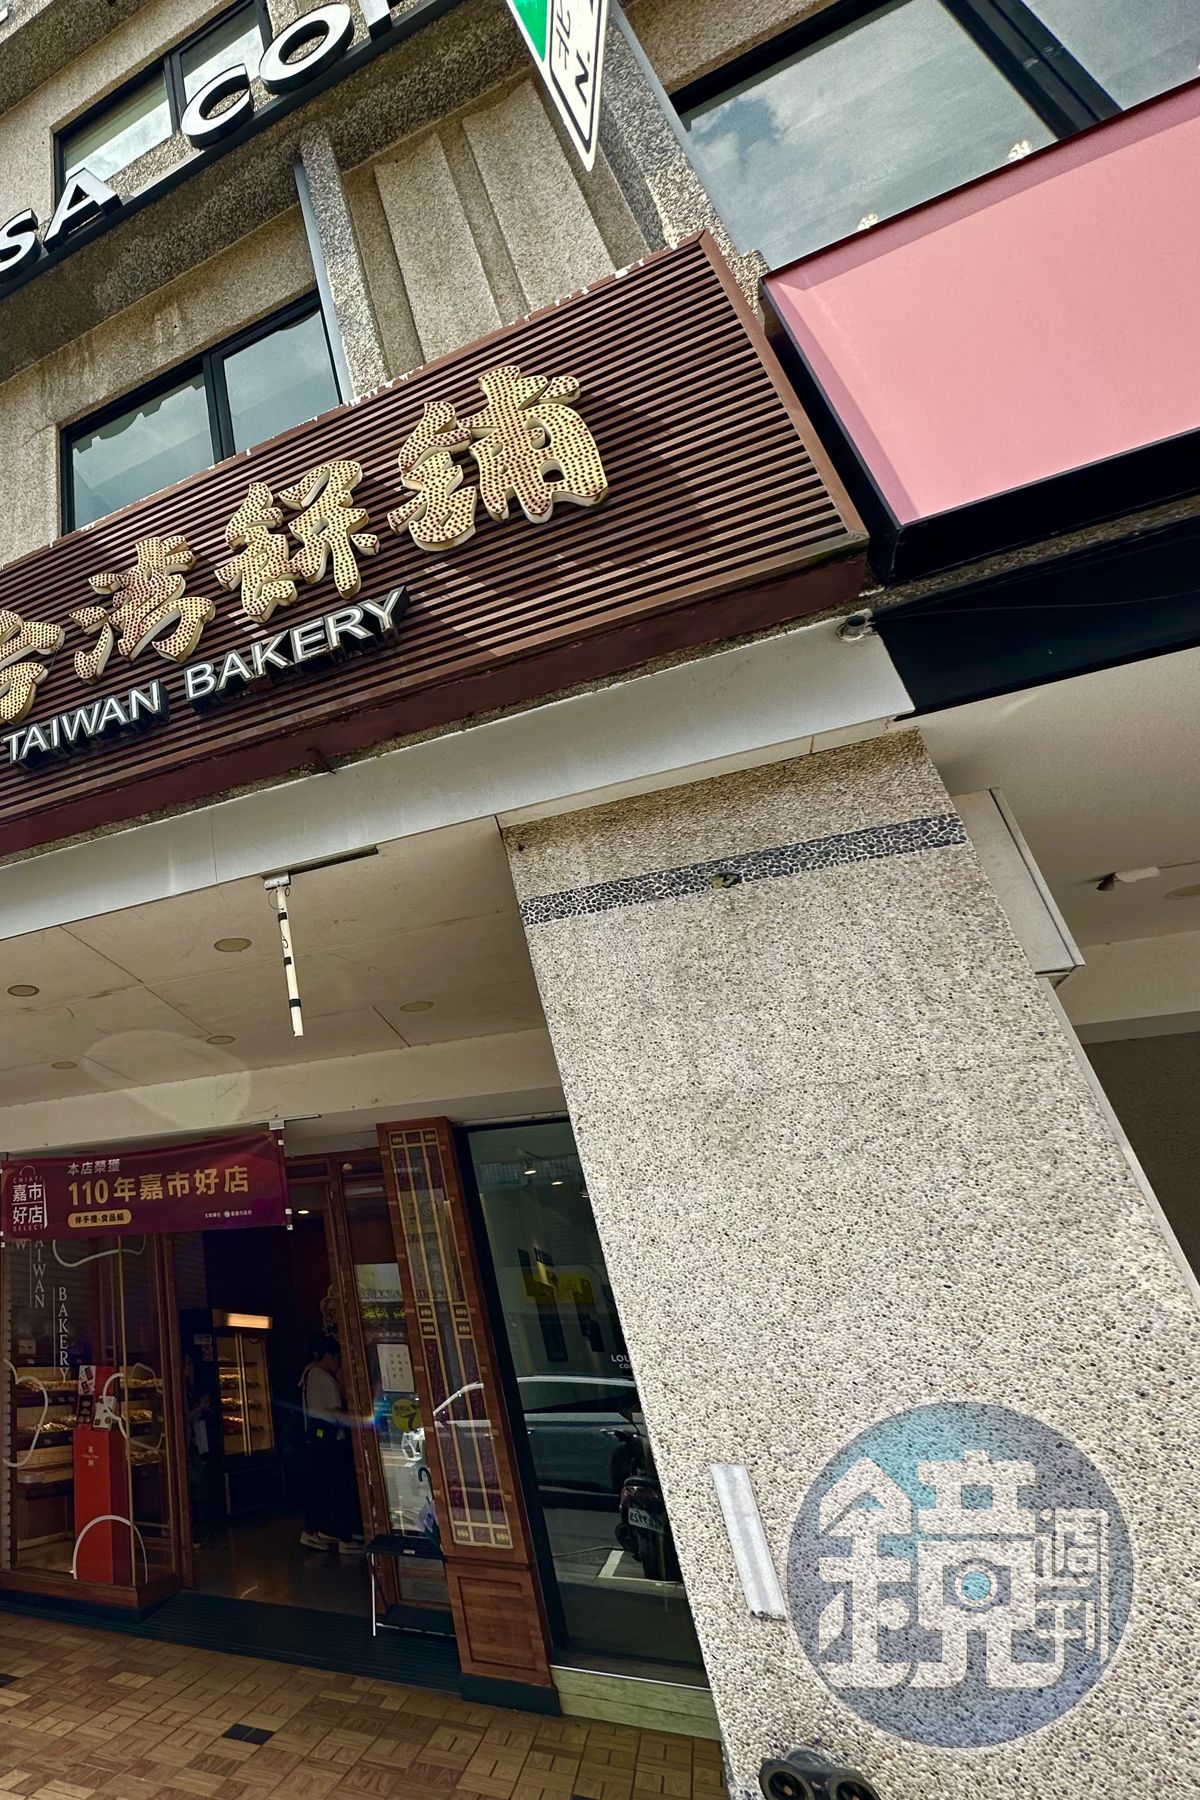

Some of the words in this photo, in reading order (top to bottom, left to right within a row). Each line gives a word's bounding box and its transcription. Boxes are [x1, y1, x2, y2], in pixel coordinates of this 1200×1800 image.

[3, 679, 167, 764] TAIWAN
[185, 585, 408, 701] BAKERY
[67, 1158, 121, 1176] 本店榮獲
[12, 1182, 43, 1203] 嘉市
[67, 1165, 250, 1207] 110年嘉市好店
[12, 1205, 44, 1225] 好店
[12, 1223, 44, 1232] SELECT
[57, 1286, 71, 1383] BAKERY
